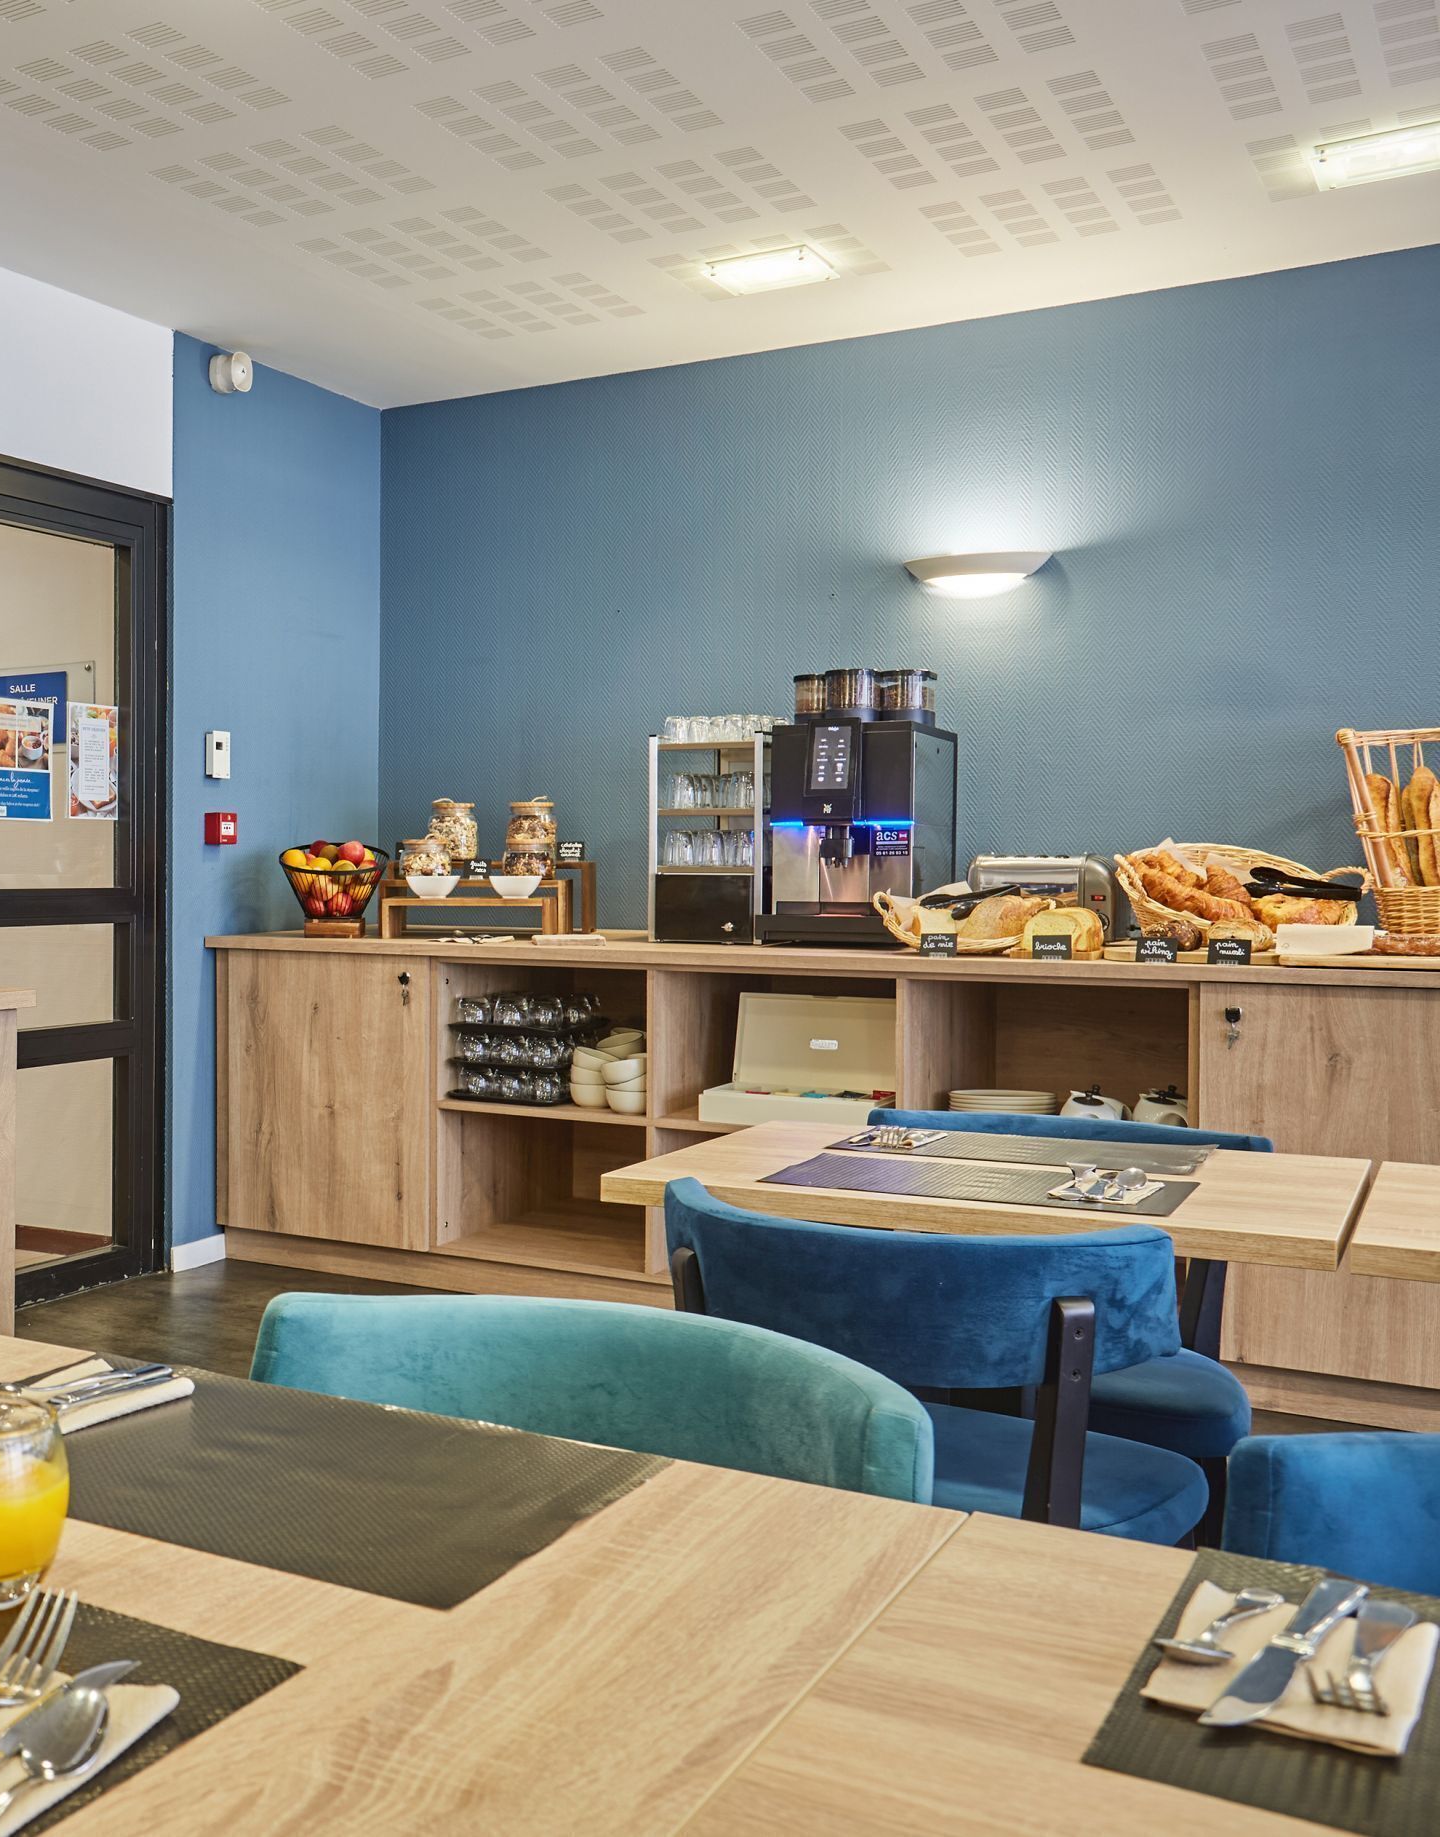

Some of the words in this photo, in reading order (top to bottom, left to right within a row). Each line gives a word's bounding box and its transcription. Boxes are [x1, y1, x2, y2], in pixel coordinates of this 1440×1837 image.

[10, 684, 36, 694] SALLE
[876, 831, 898, 841] acs
[927, 934, 950, 943] pain
[922, 941, 936, 949] de
[1035, 941, 1067, 950] brioche
[1145, 940, 1168, 948] pain
[1215, 941, 1239, 950] pain
